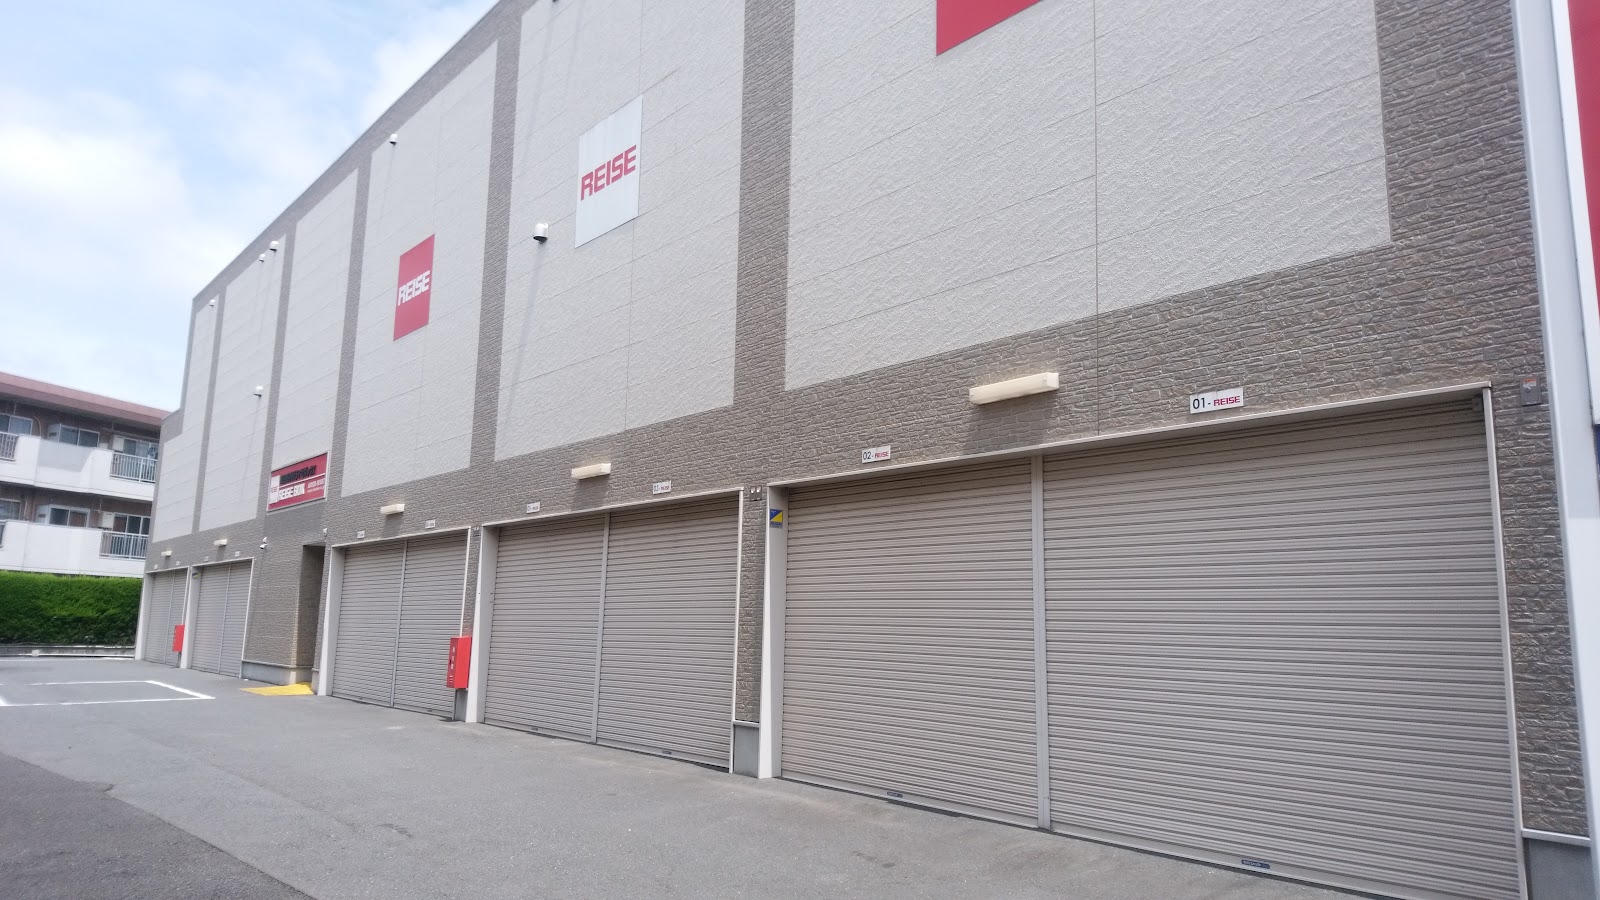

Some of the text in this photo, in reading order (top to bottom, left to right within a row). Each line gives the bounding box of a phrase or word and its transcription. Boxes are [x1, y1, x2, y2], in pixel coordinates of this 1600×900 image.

[580, 144, 637, 202] REISE
[397, 270, 431, 307] REISE
[1213, 395, 1241, 407] REISE
